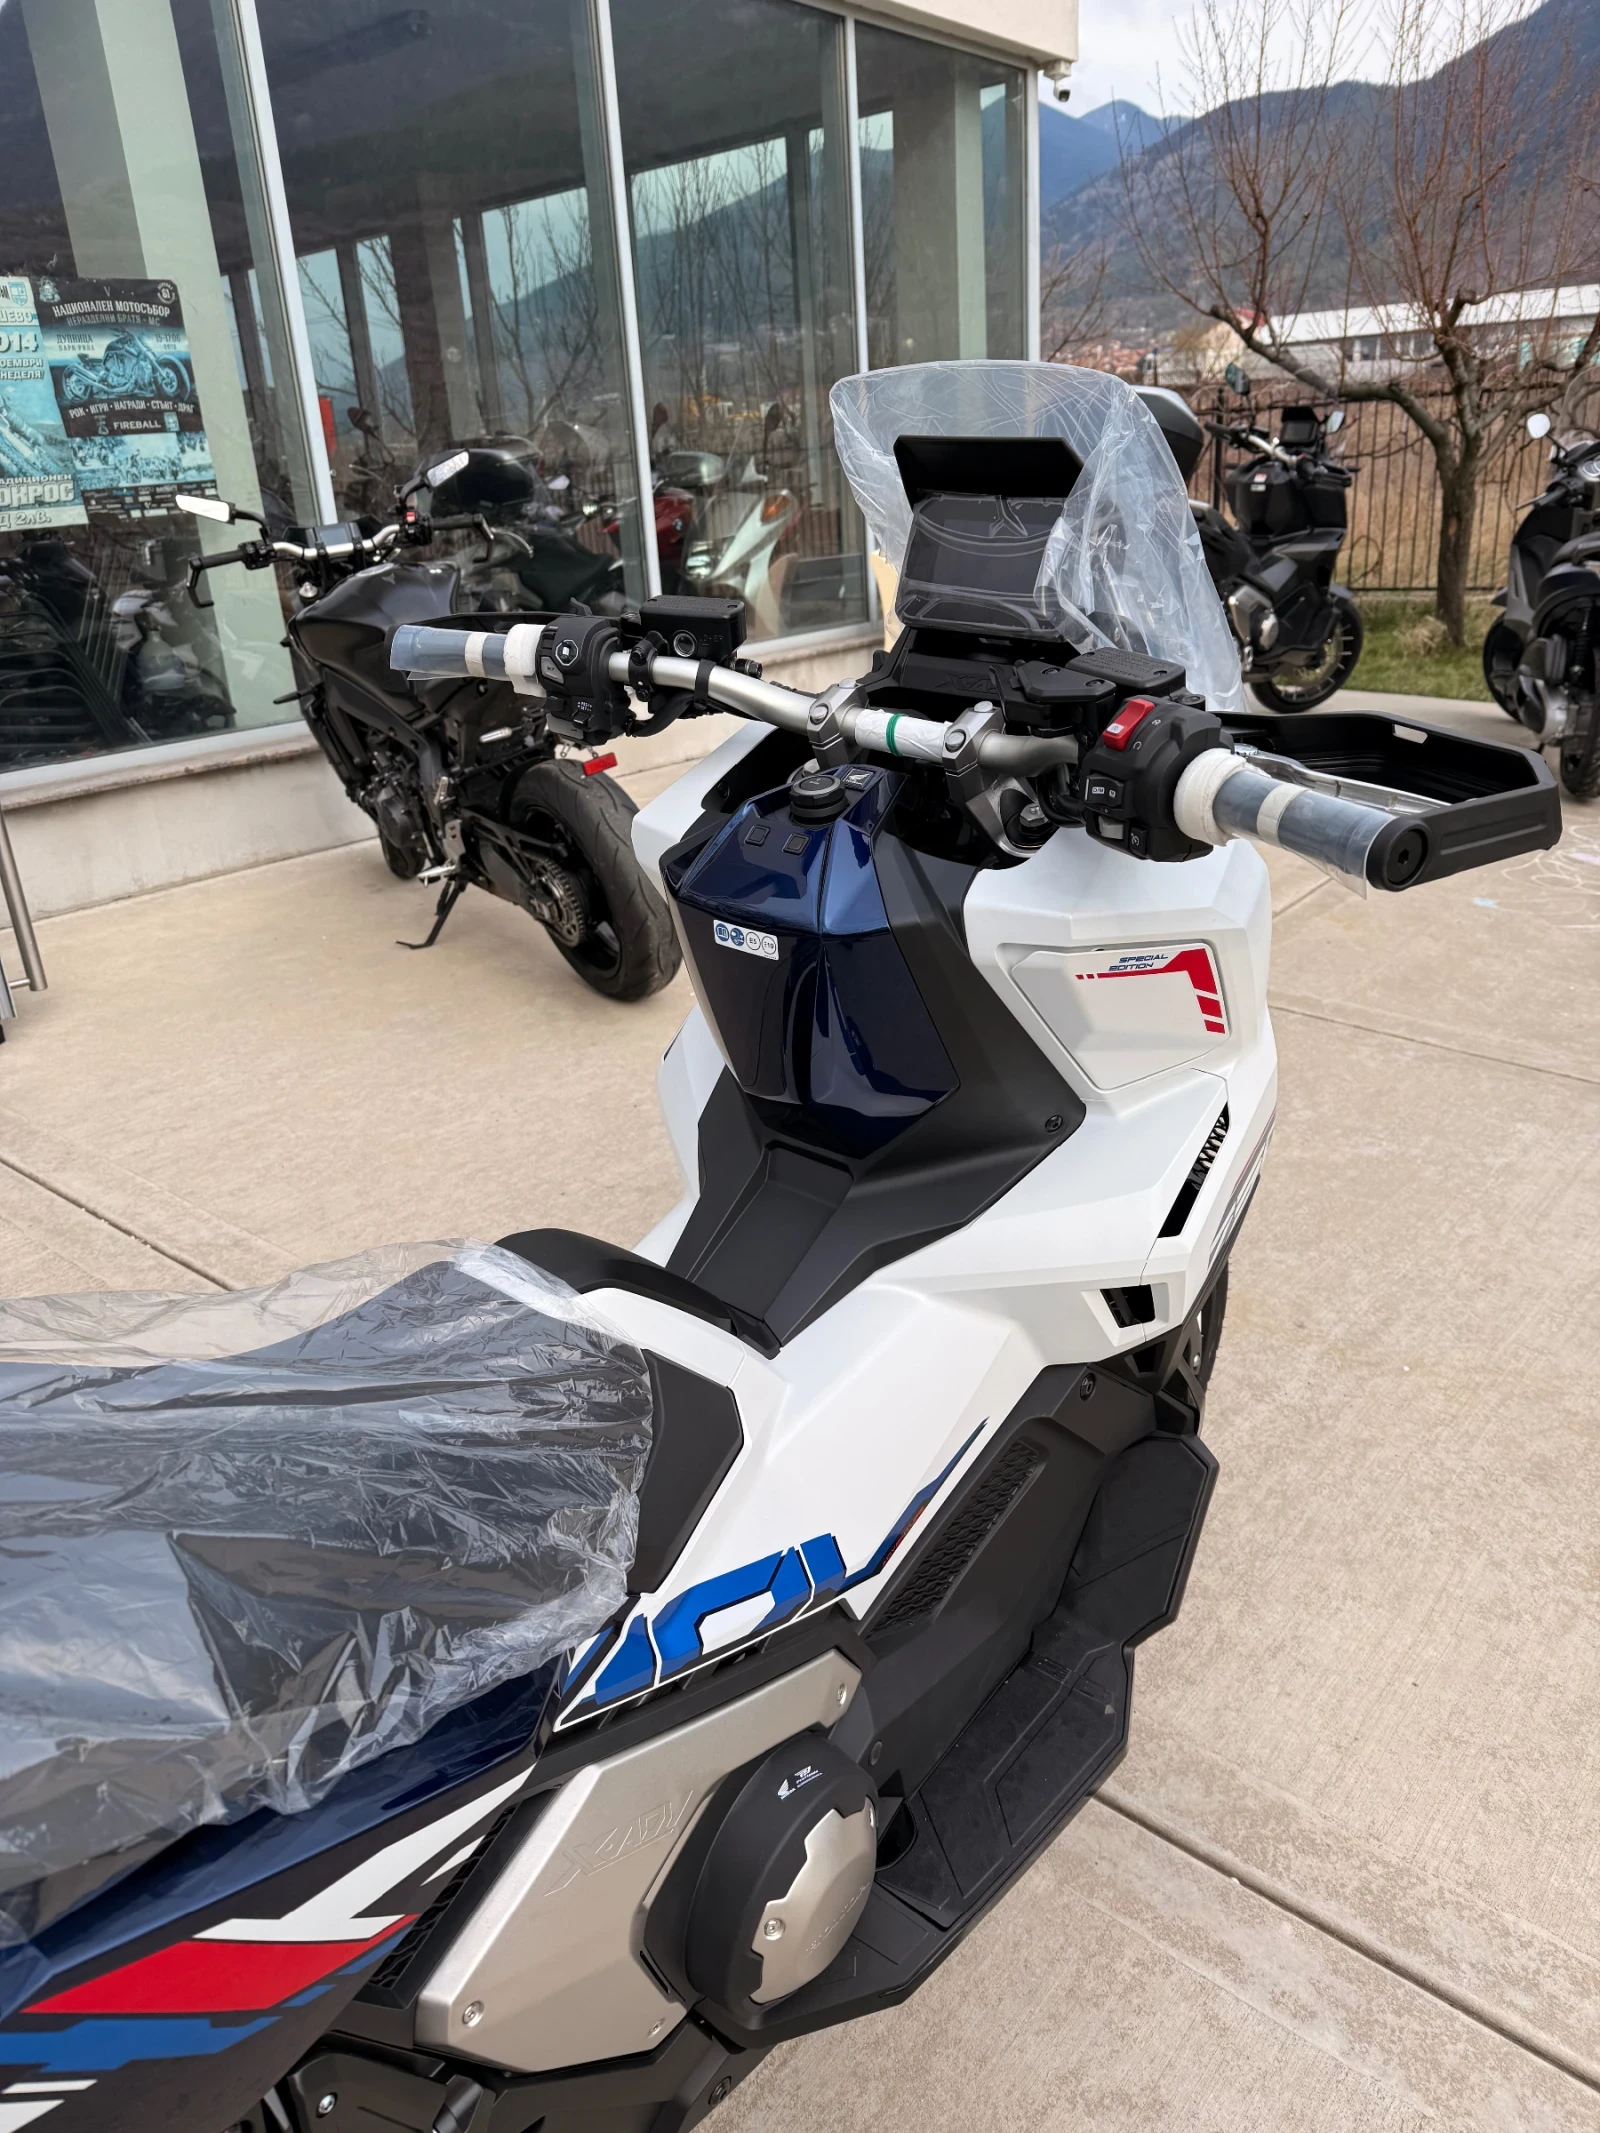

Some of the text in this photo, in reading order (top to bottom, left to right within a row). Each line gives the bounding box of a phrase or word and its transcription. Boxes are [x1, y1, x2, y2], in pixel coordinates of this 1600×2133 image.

[52, 300, 170, 318] НАЦИОНАЛЕН МОТОСЪБОР
[56, 333, 93, 344] ДУПНИЦА
[69, 407, 85, 418] РОК
[90, 403, 109, 414] ИГРИ
[114, 400, 146, 411] НАГРАДИ
[113, 420, 161, 430] FIREBALL
[1118, 954, 1169, 963] SPECIAL
[1108, 962, 1154, 971] EDITION
